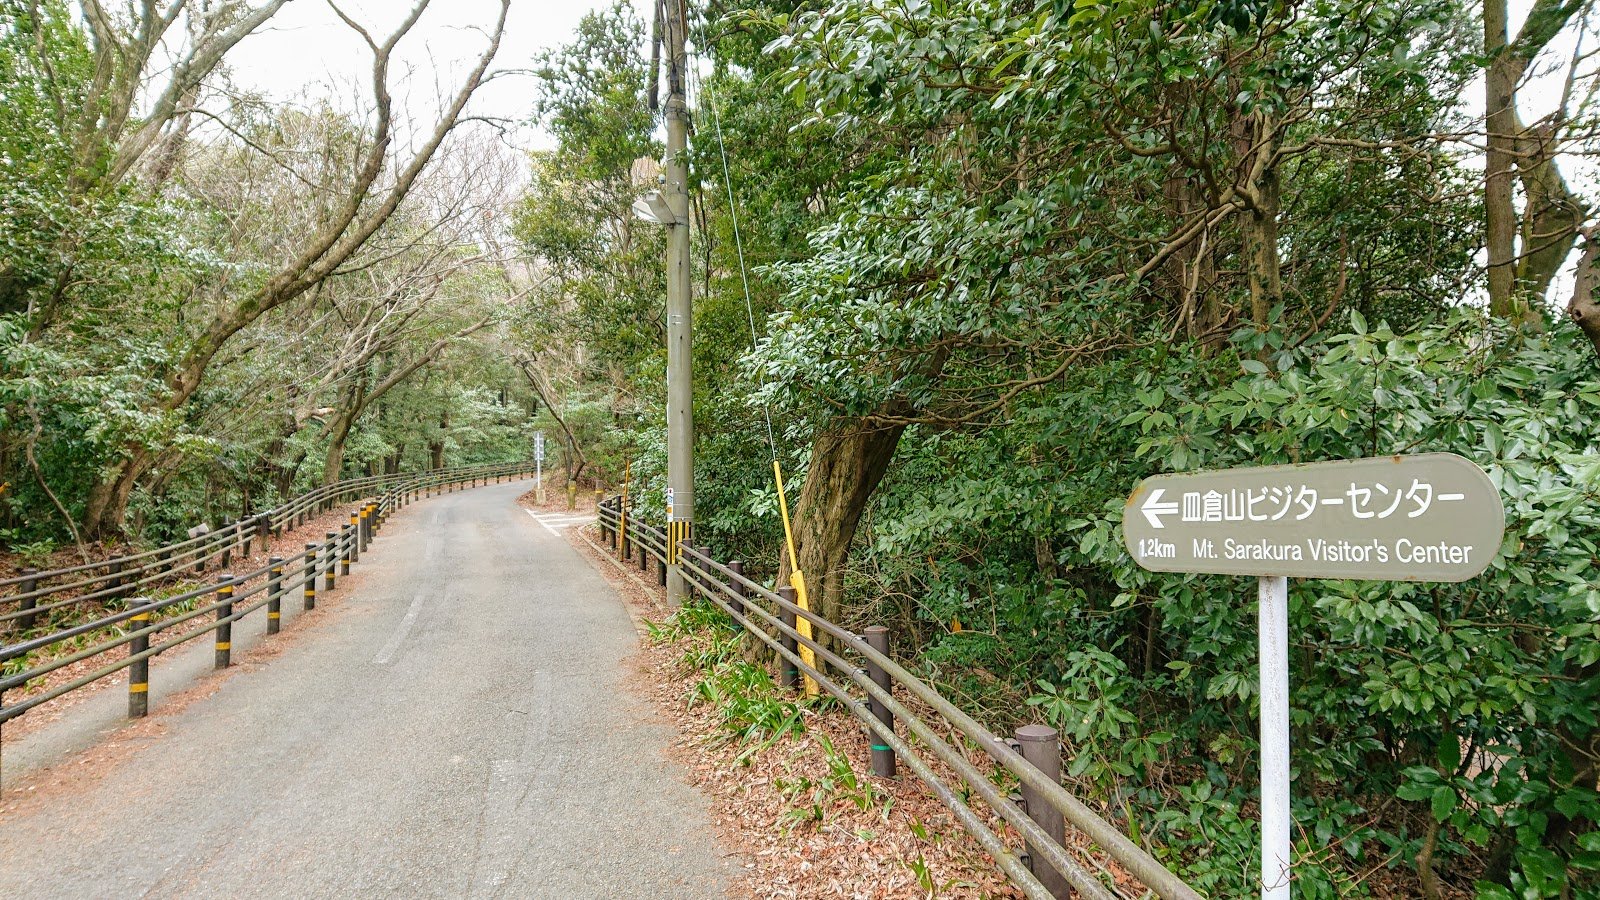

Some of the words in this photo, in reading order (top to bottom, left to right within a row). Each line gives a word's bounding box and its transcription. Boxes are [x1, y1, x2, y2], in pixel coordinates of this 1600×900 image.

[1182, 478, 1465, 522] 皿倉山ビジターセンター
[1139, 538, 1176, 558] 1.2km
[1193, 540, 1219, 560] Mt.
[1224, 538, 1303, 561] Sarakura
[1307, 537, 1388, 563] Visitor's
[1395, 538, 1473, 564] Center
